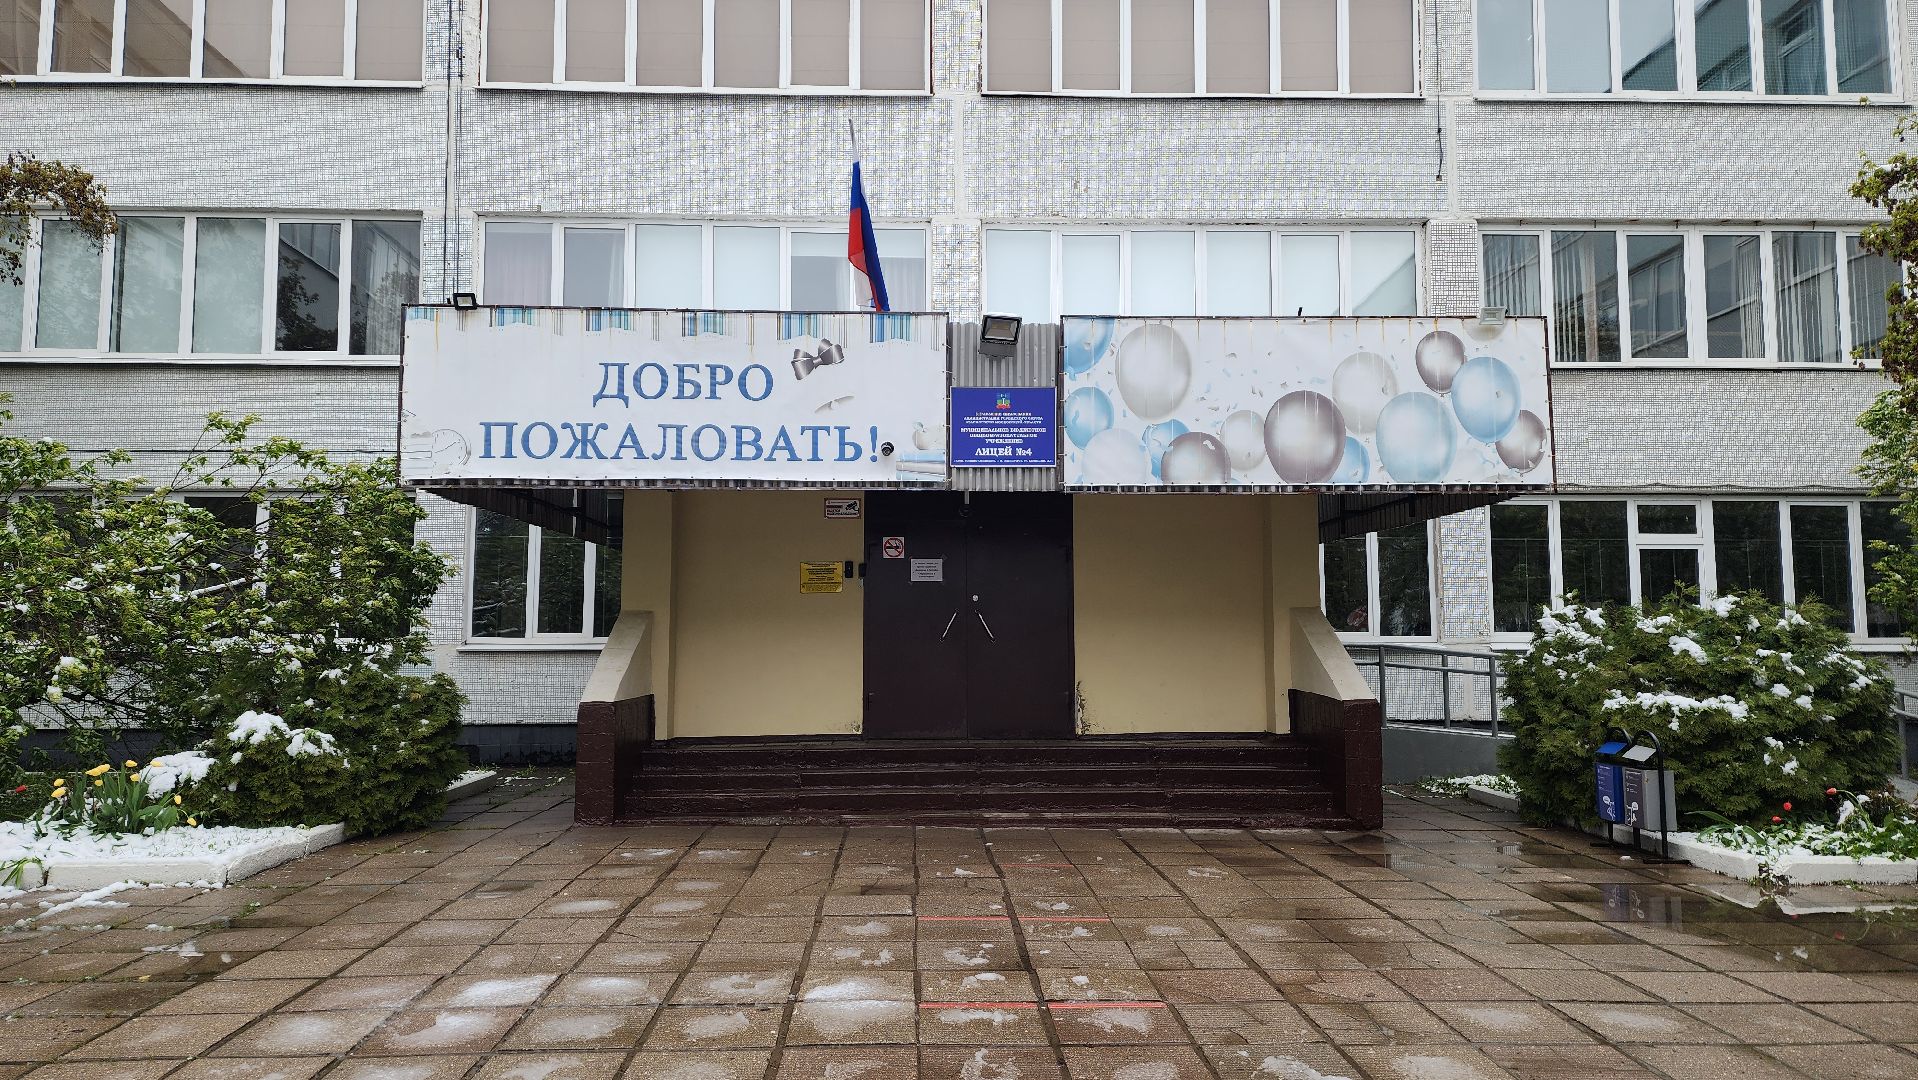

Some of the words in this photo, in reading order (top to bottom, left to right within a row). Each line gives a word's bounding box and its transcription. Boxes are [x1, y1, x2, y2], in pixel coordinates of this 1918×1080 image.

[592, 362, 774, 408] ДОБРО
[478, 421, 879, 463] ПОЖАЛОВАТЬ!
[975, 446, 1012, 457] ЛИЦЕЙ
[1015, 447, 1032, 456] №4
